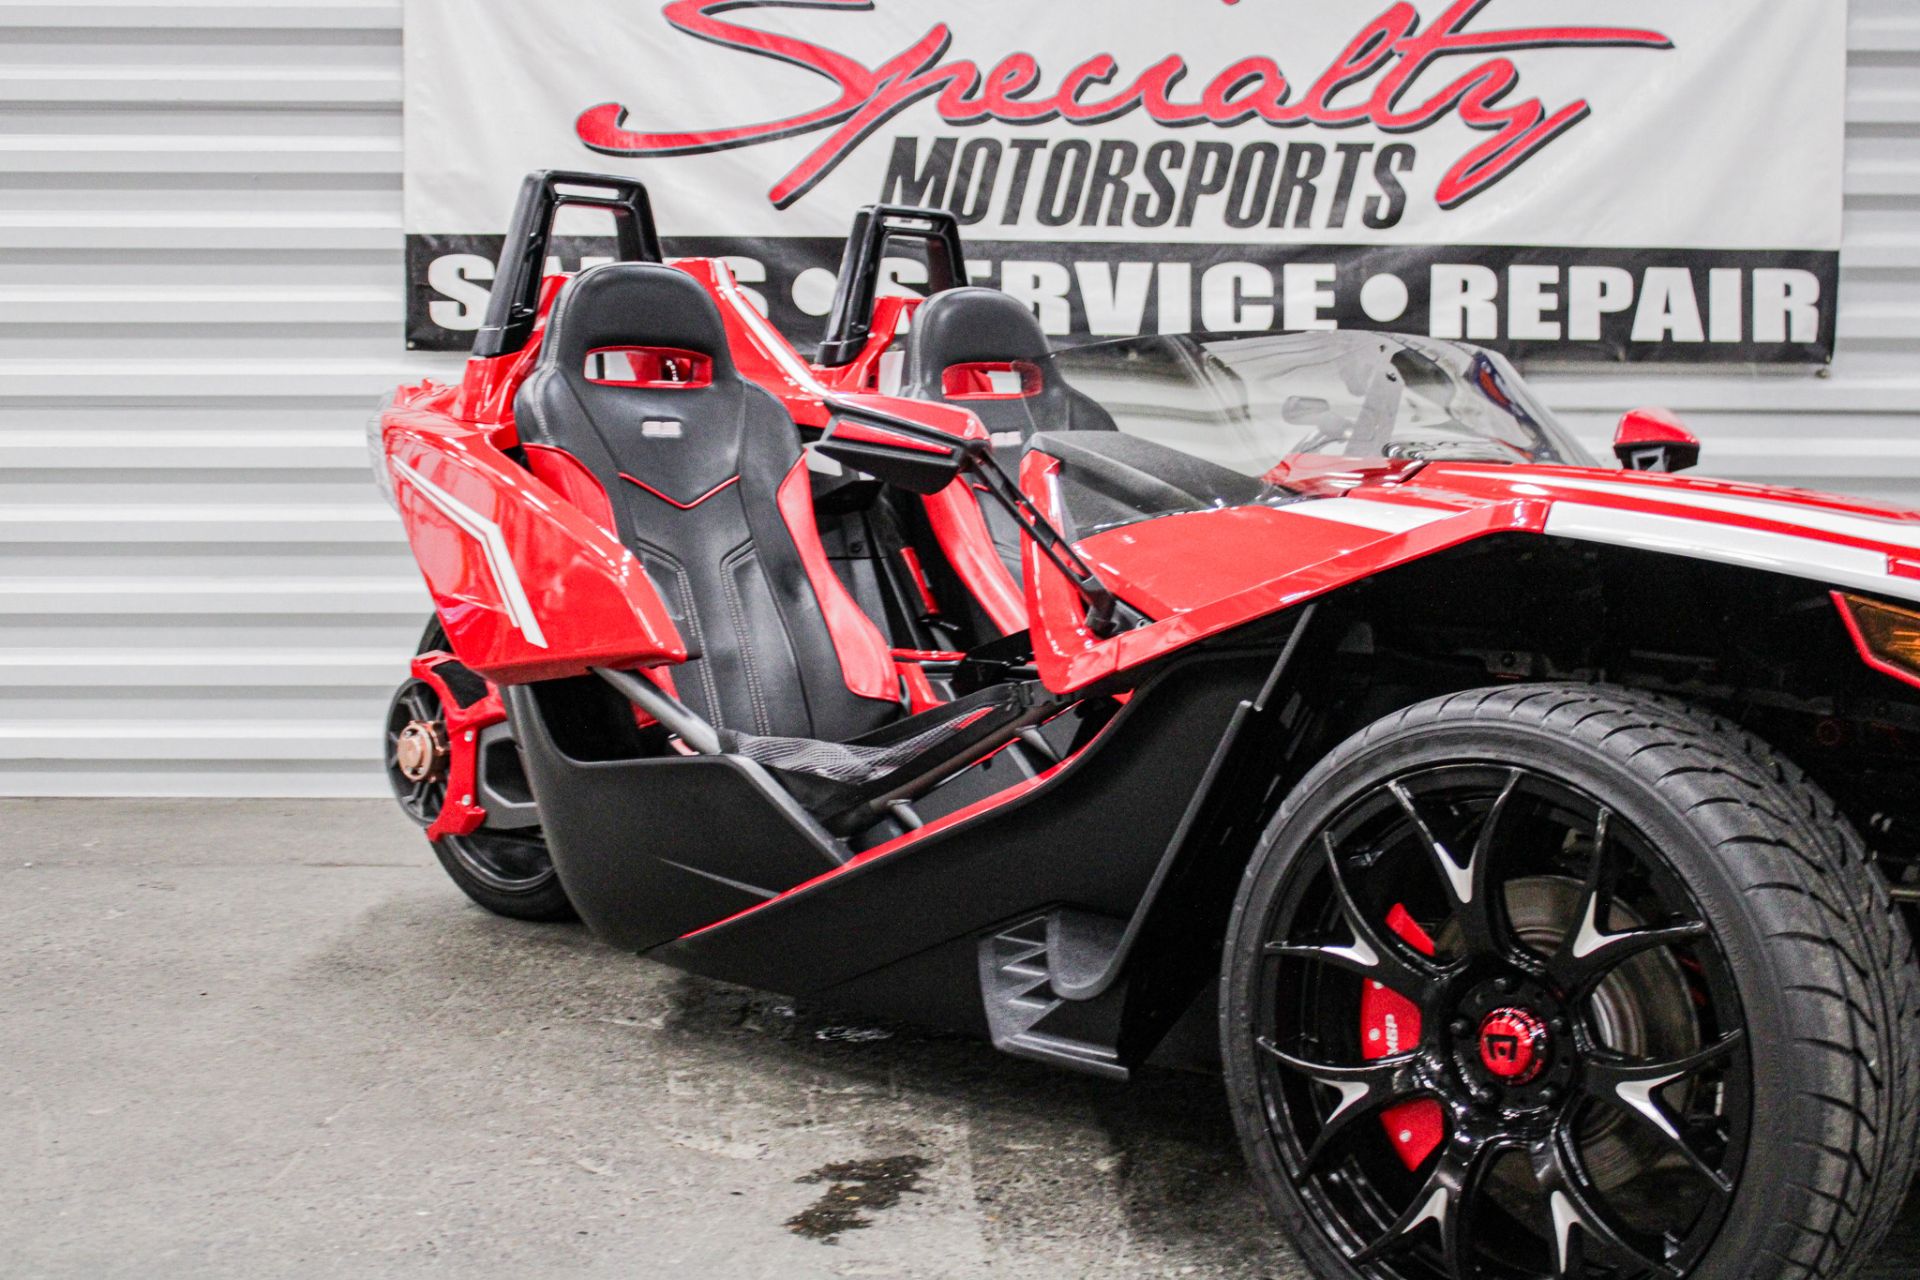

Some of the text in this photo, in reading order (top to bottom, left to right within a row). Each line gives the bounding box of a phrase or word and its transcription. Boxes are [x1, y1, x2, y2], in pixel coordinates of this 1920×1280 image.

[577, 0, 1674, 208] Specialty
[881, 136, 1417, 230] MOTORSPORTS
[874, 257, 1820, 343] SRVICE REPAIR
